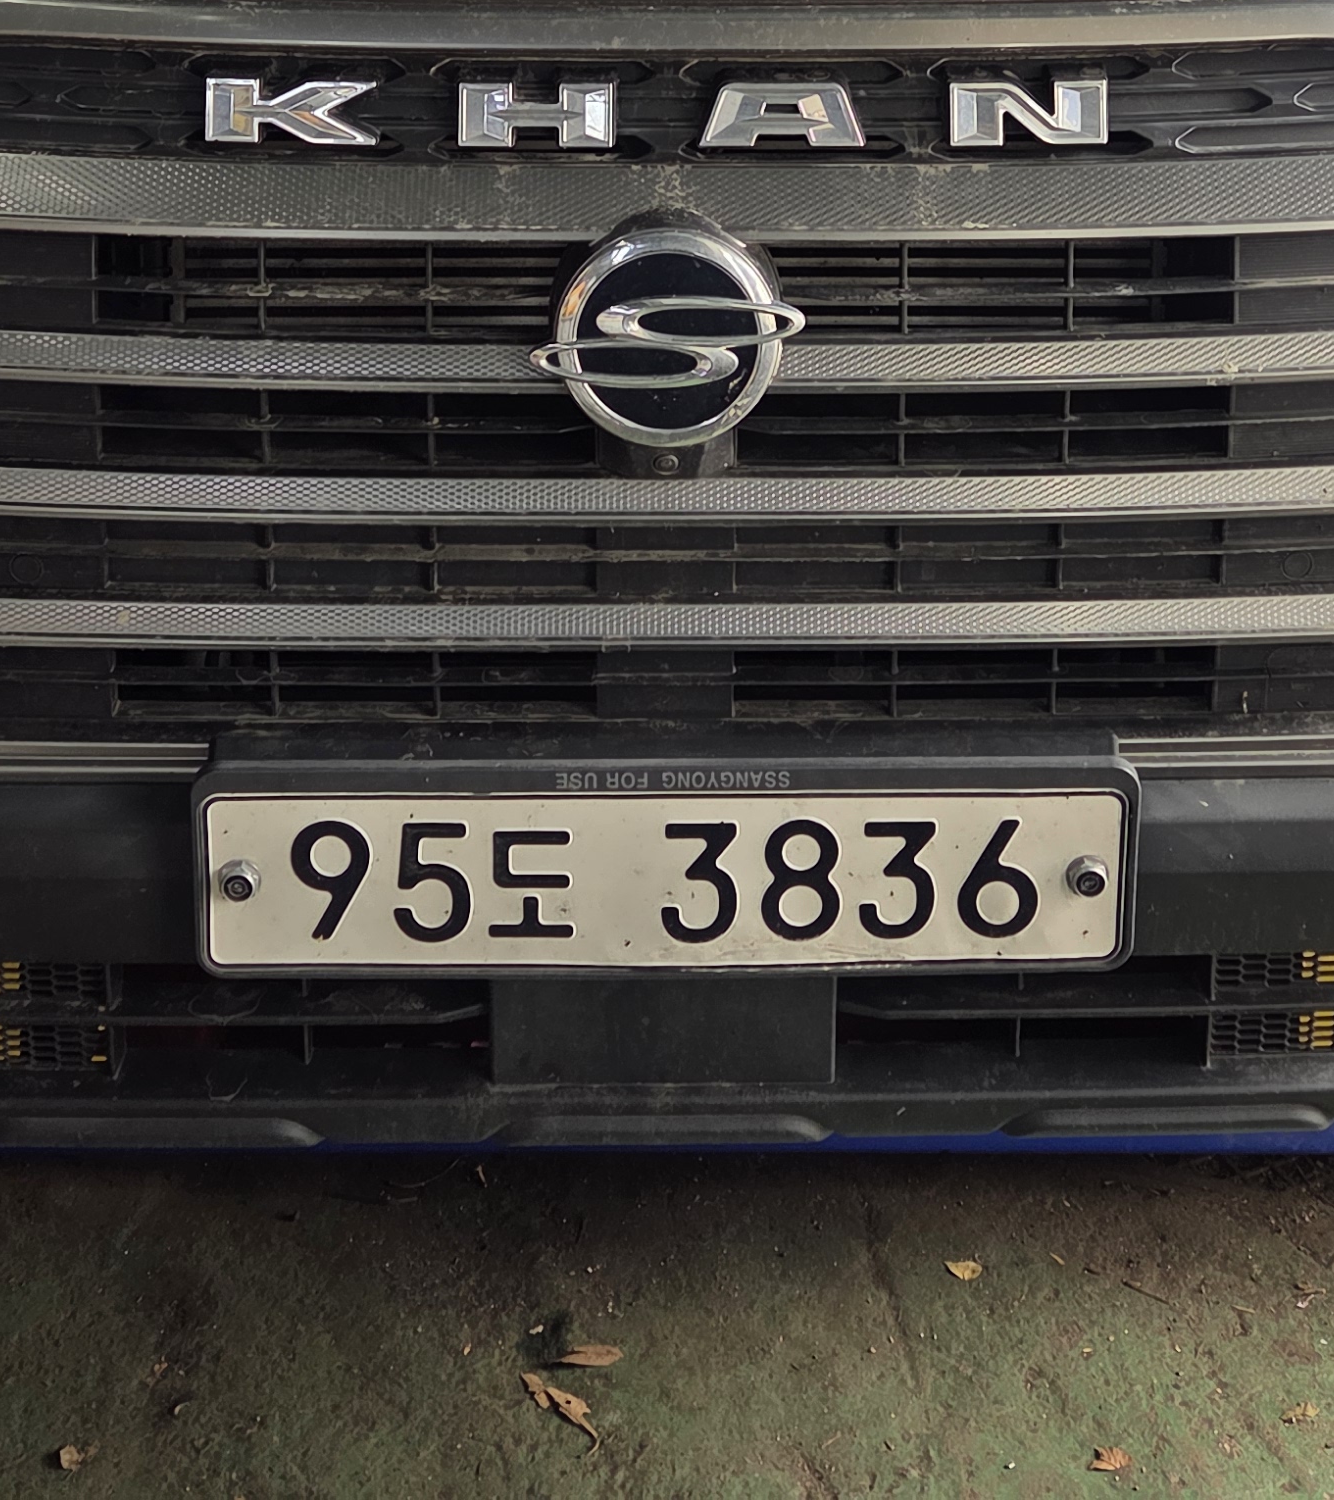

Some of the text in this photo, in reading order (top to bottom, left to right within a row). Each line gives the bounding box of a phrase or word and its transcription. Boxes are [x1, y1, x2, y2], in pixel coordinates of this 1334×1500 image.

[204, 76, 1109, 148] KHAN
[555, 771, 791, 790] SSANGYONG FOR USE
[289, 818, 1039, 943] 95도 3836
